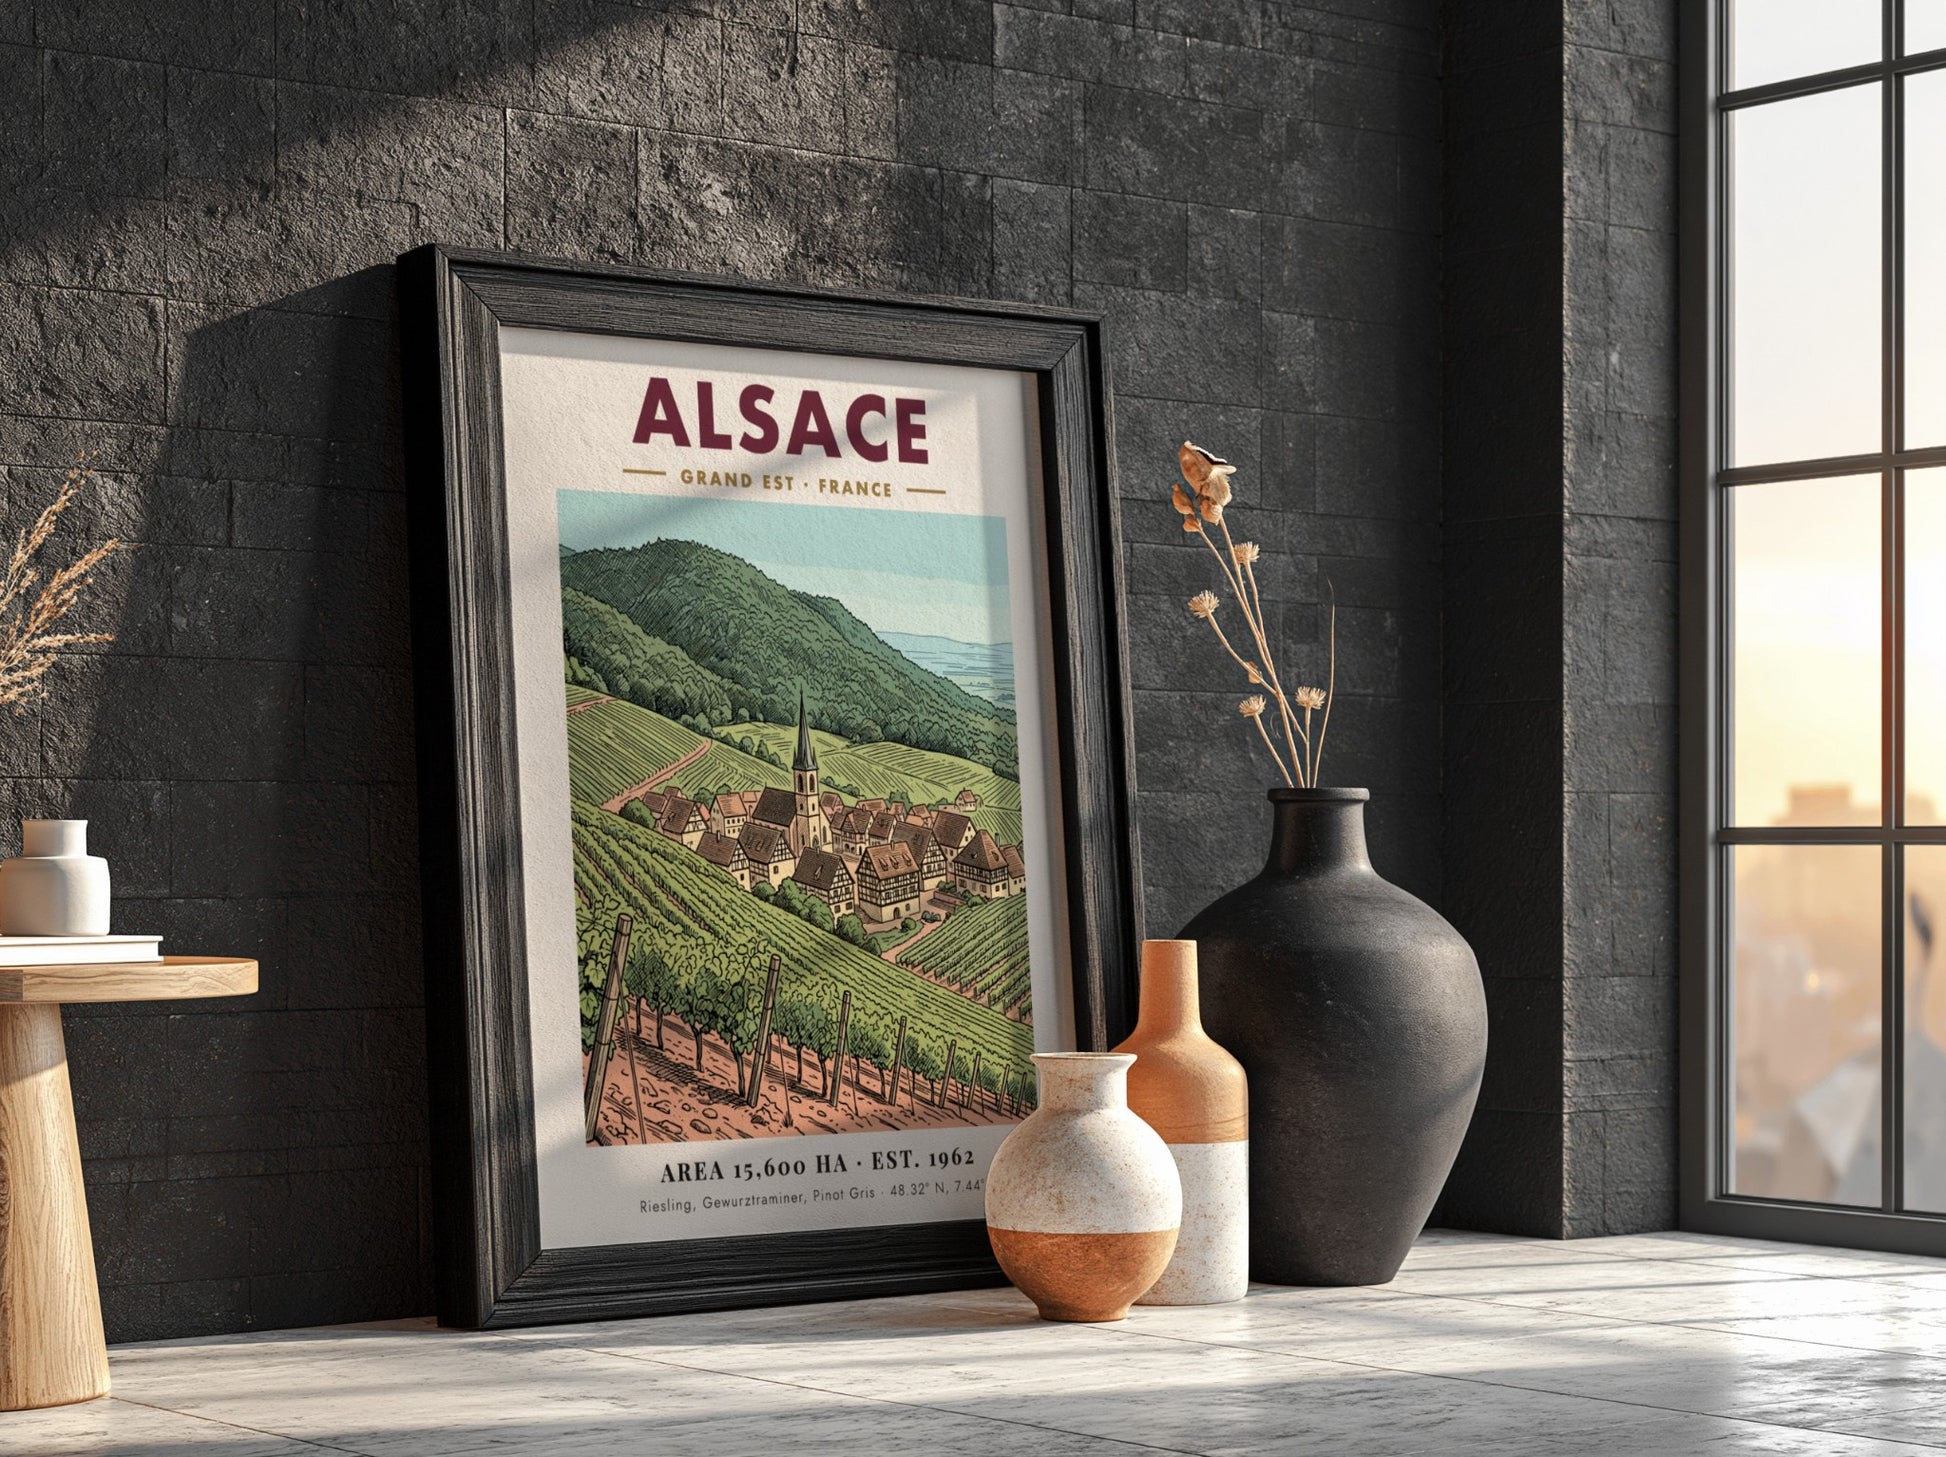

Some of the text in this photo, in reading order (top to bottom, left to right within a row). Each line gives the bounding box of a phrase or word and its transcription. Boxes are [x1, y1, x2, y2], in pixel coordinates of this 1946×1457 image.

[632, 377, 929, 465] ALSACE
[680, 469, 892, 497] GRAND EST FRANCE
[661, 1147, 975, 1183] AREA 15,600 HA EST. 1962
[640, 1200, 697, 1214] Riesling,
[702, 1190, 808, 1209] Gewurztraminer,
[813, 1188, 844, 1202] Pinot
[849, 1186, 876, 1200] Gris
[890, 1183, 930, 1197] 48.32°
[935, 1181, 949, 1195] N,
